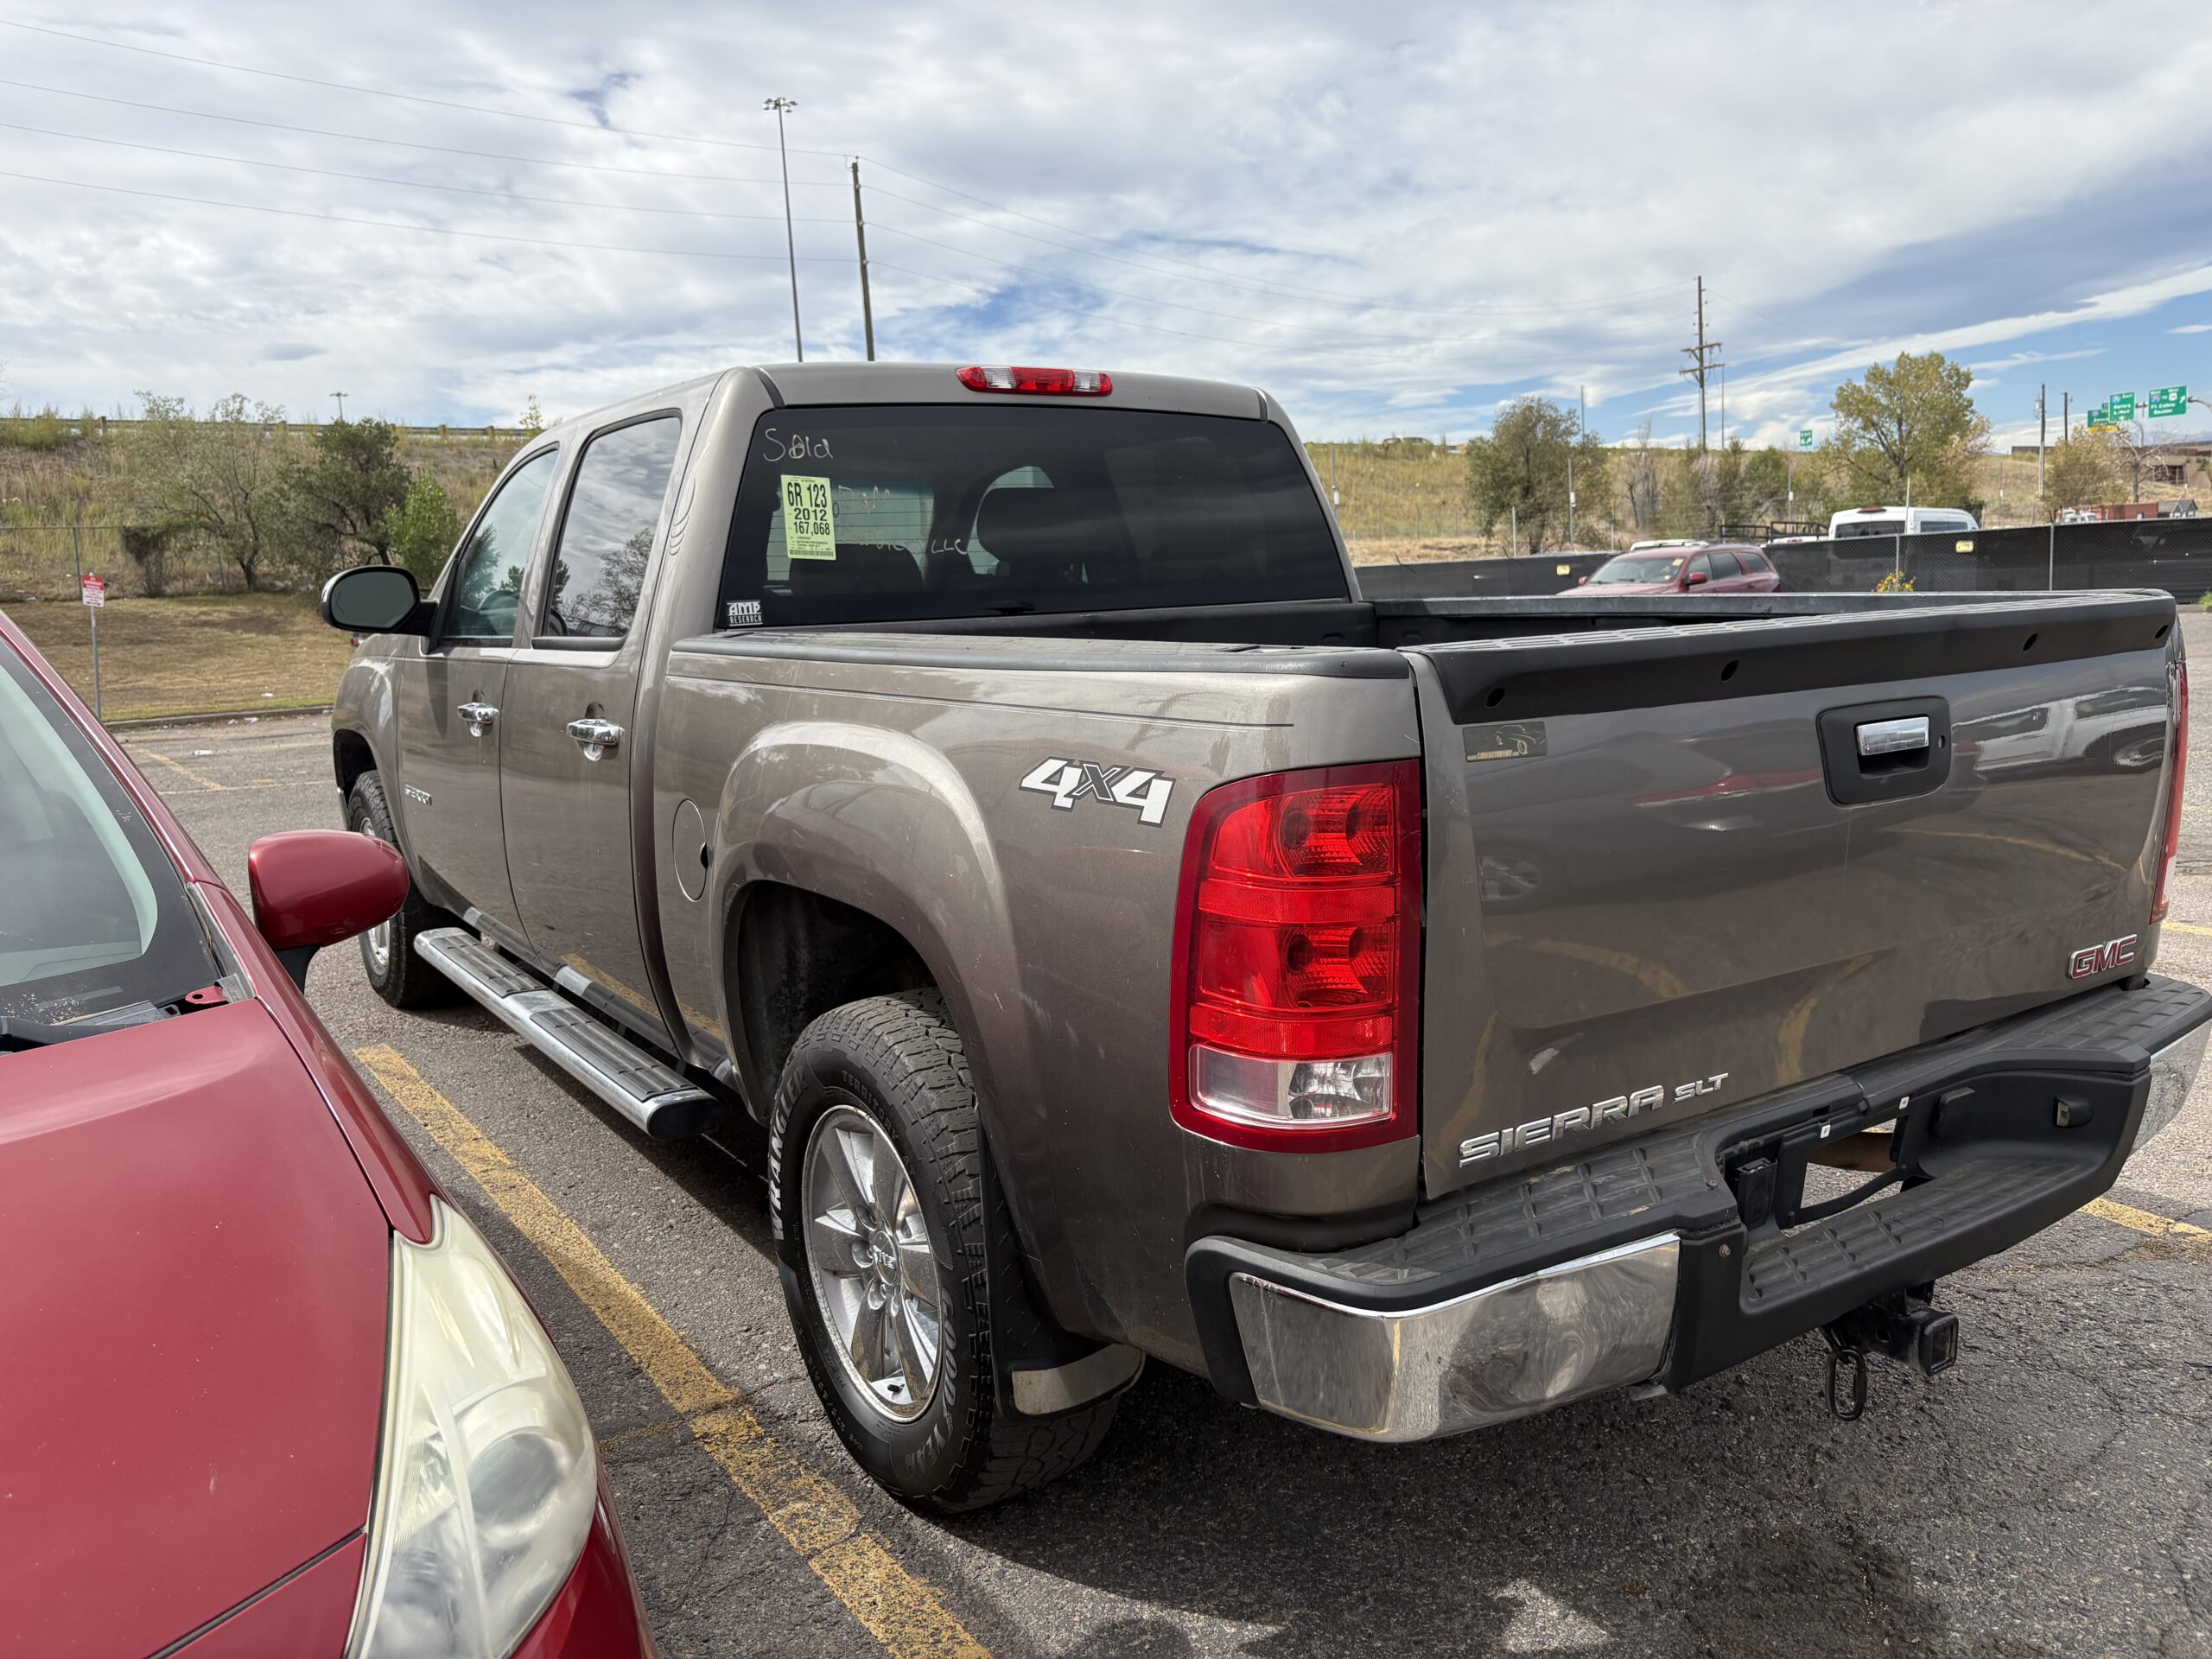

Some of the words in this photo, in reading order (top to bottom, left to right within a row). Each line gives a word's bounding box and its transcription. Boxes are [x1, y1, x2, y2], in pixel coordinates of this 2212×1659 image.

[762, 427, 835, 463] Sold
[787, 482, 804, 507] 6R
[807, 483, 827, 508] 123
[793, 507, 828, 522] 2012
[793, 521, 830, 537] 167,068
[728, 601, 762, 616] AMP
[729, 614, 762, 626] RESEARCH
[2068, 933, 2138, 979] GMC
[842, 1070, 899, 1140] TERRITORY
[1458, 1084, 1665, 1169] SIERRA
[1673, 1072, 1729, 1103] SLT
[770, 1068, 810, 1241] WRANGLER
